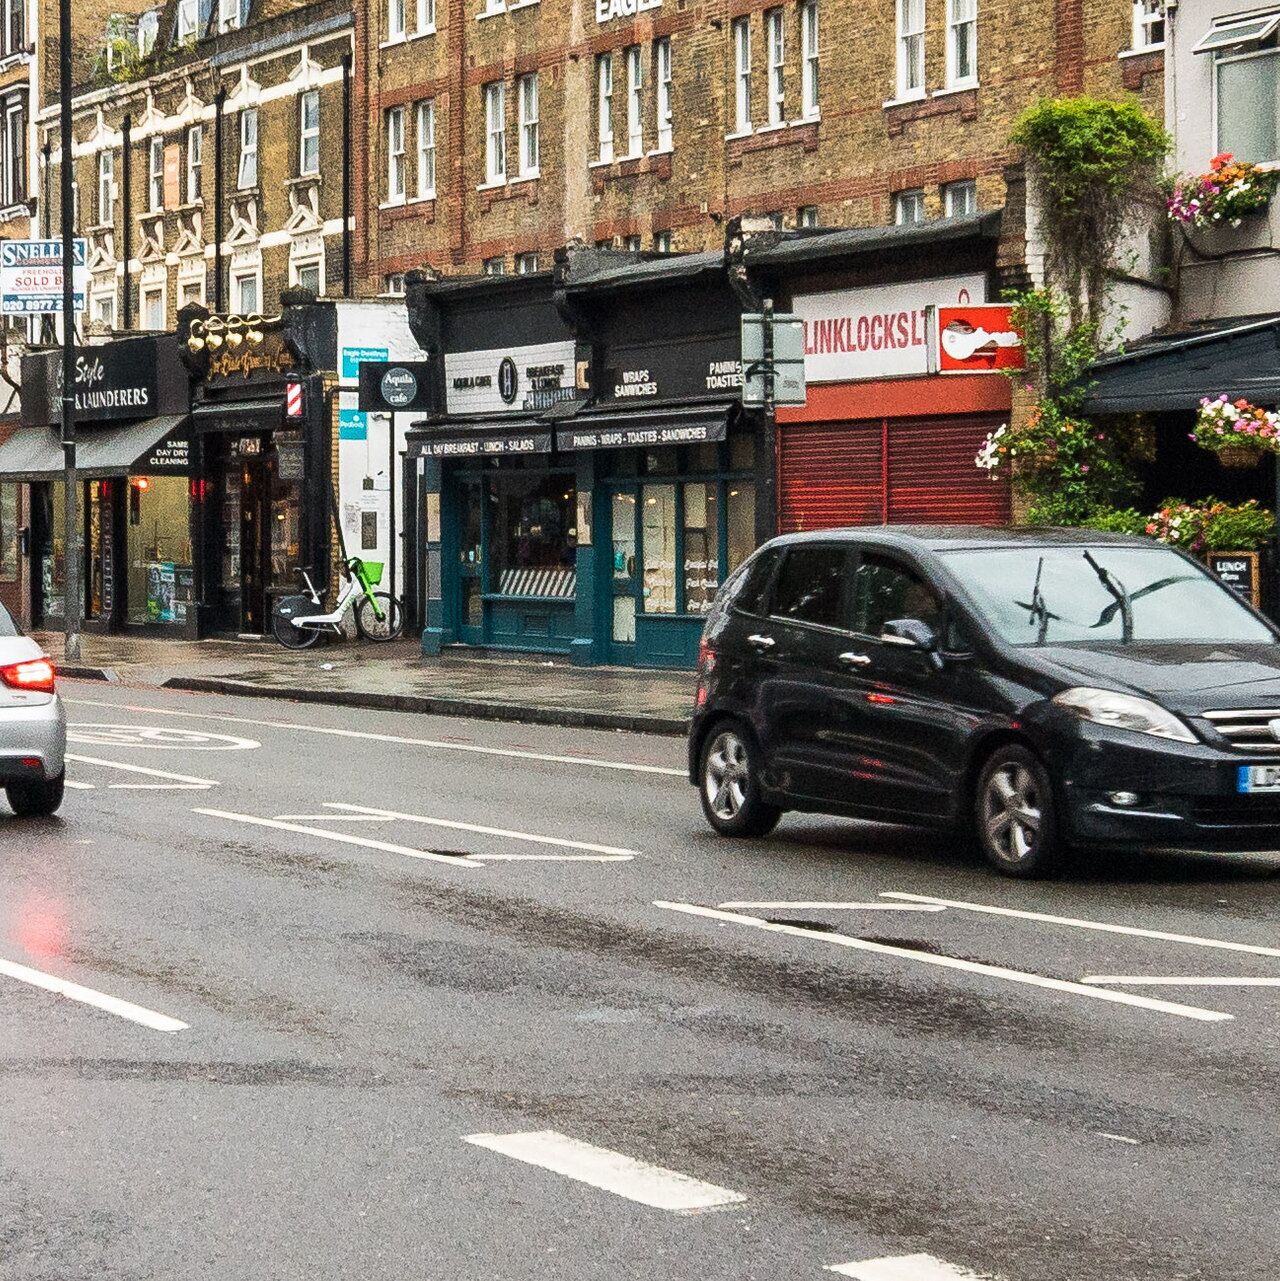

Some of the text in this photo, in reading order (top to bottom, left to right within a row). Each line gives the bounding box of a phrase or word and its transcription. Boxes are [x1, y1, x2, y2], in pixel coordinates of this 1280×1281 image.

[15, 276, 49, 286] SOLD
[75, 356, 105, 388] Style
[622, 369, 650, 384] WRAPS
[384, 373, 414, 387] Aquila
[706, 373, 744, 390] TOASTIES
[74, 393, 83, 410] &
[83, 387, 149, 409] LAUNDERERS
[627, 430, 658, 443] TOASTIES
[149, 457, 189, 466] CLEANING
